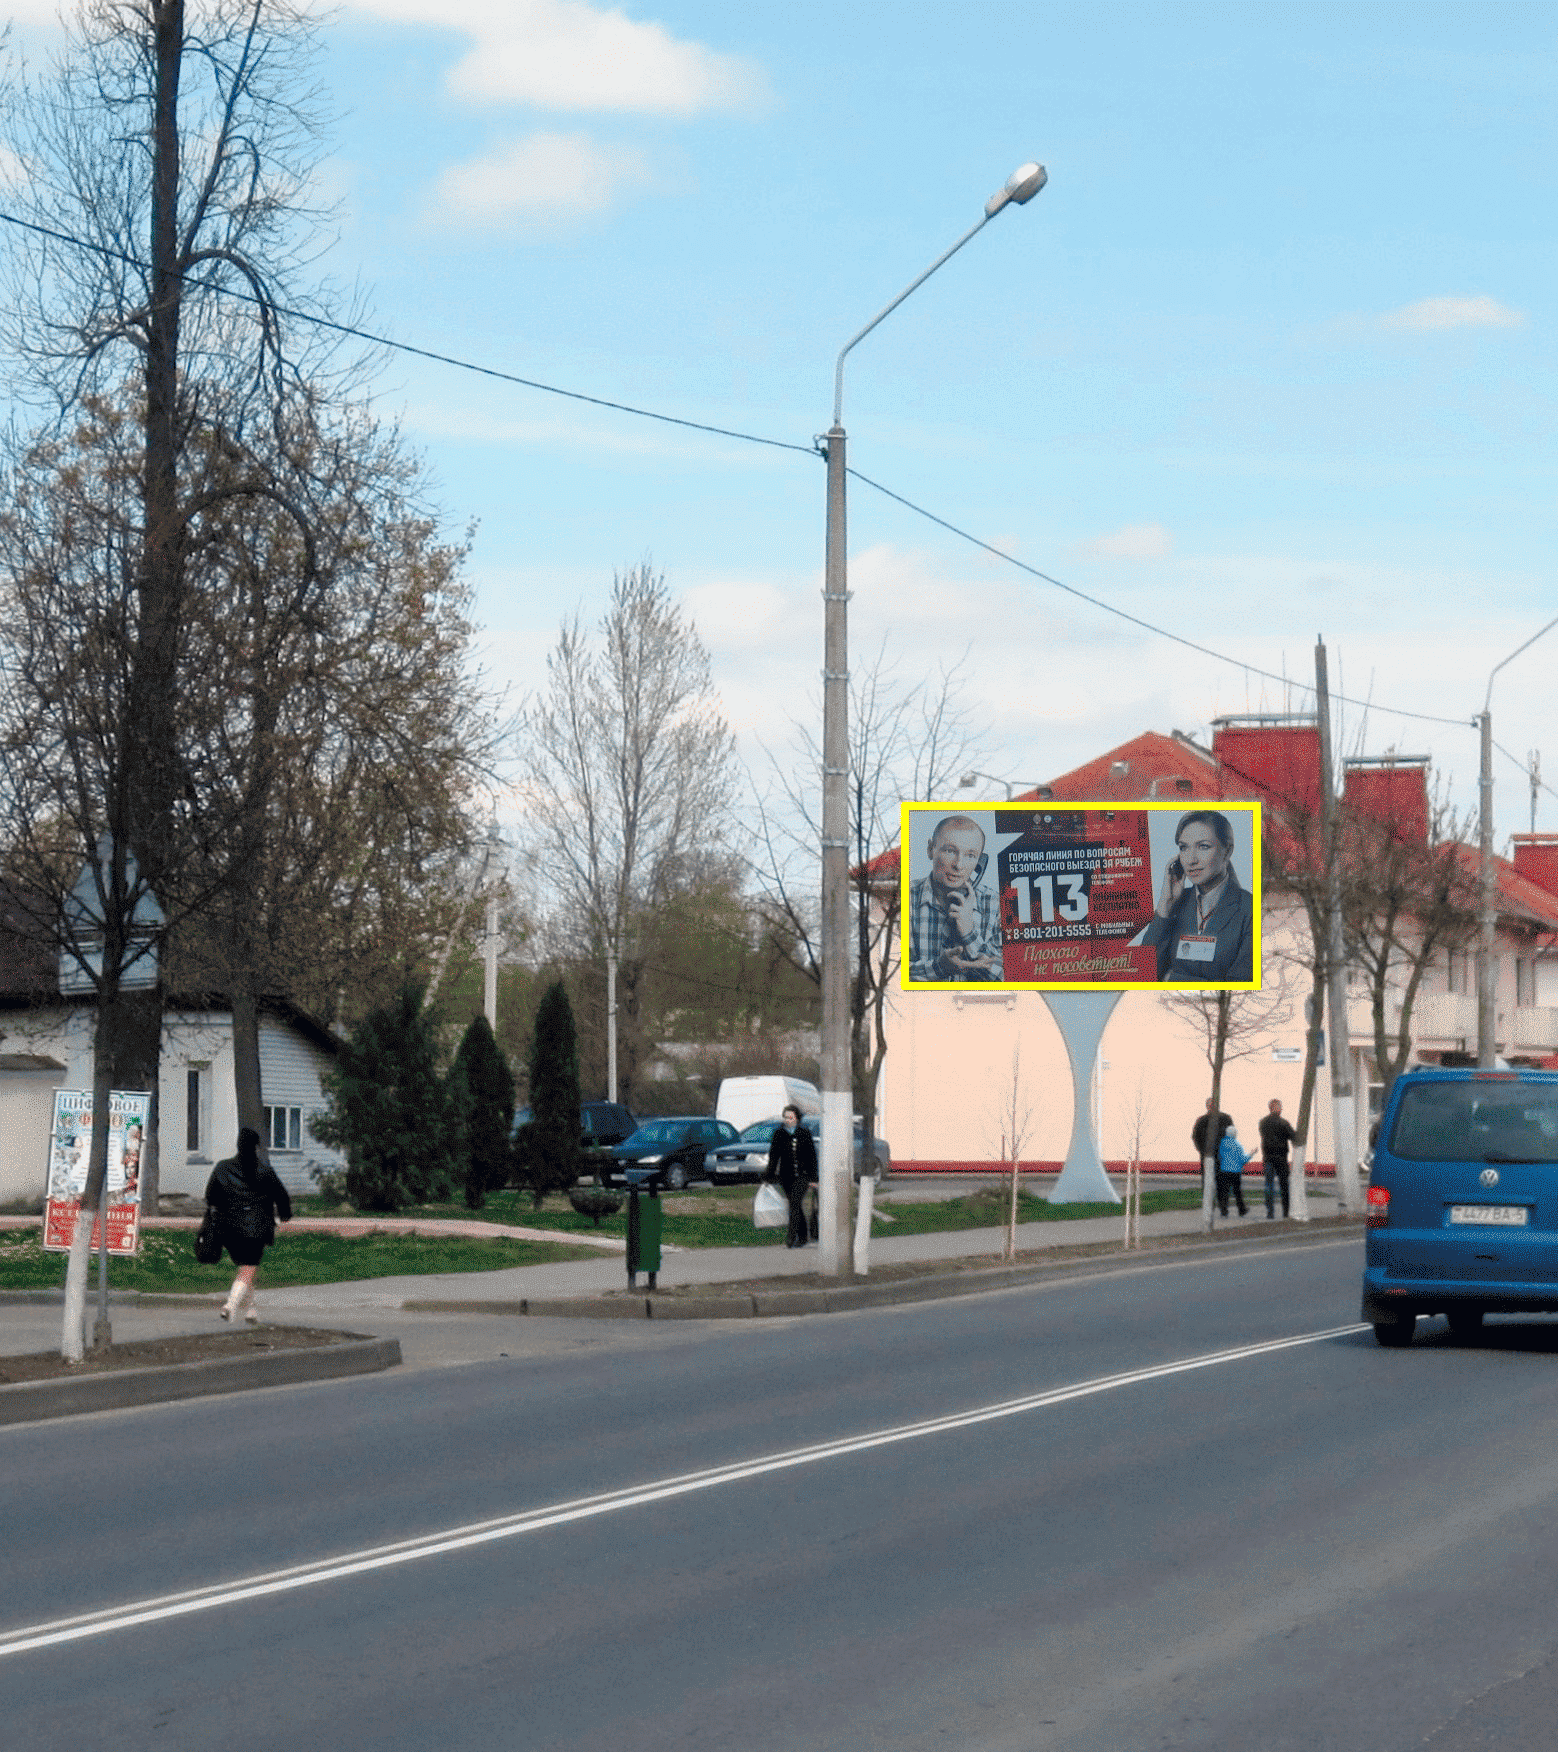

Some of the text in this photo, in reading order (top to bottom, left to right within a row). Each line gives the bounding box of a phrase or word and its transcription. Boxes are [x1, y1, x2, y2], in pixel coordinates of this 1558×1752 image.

[1008, 846, 1131, 863] ГОРЯЧАЯ ЛИНИЯ ПО ВОПРОСАМ
[1009, 856, 1143, 874] БЕЗОПАСНОГО ВЫЕЗДА ЗА РУБЕЖ
[1010, 873, 1090, 924] 113
[1013, 924, 1092, 940] 8-801-201-5555
[1023, 945, 1080, 963] Плохого
[1033, 950, 1134, 979] не посоветует!
